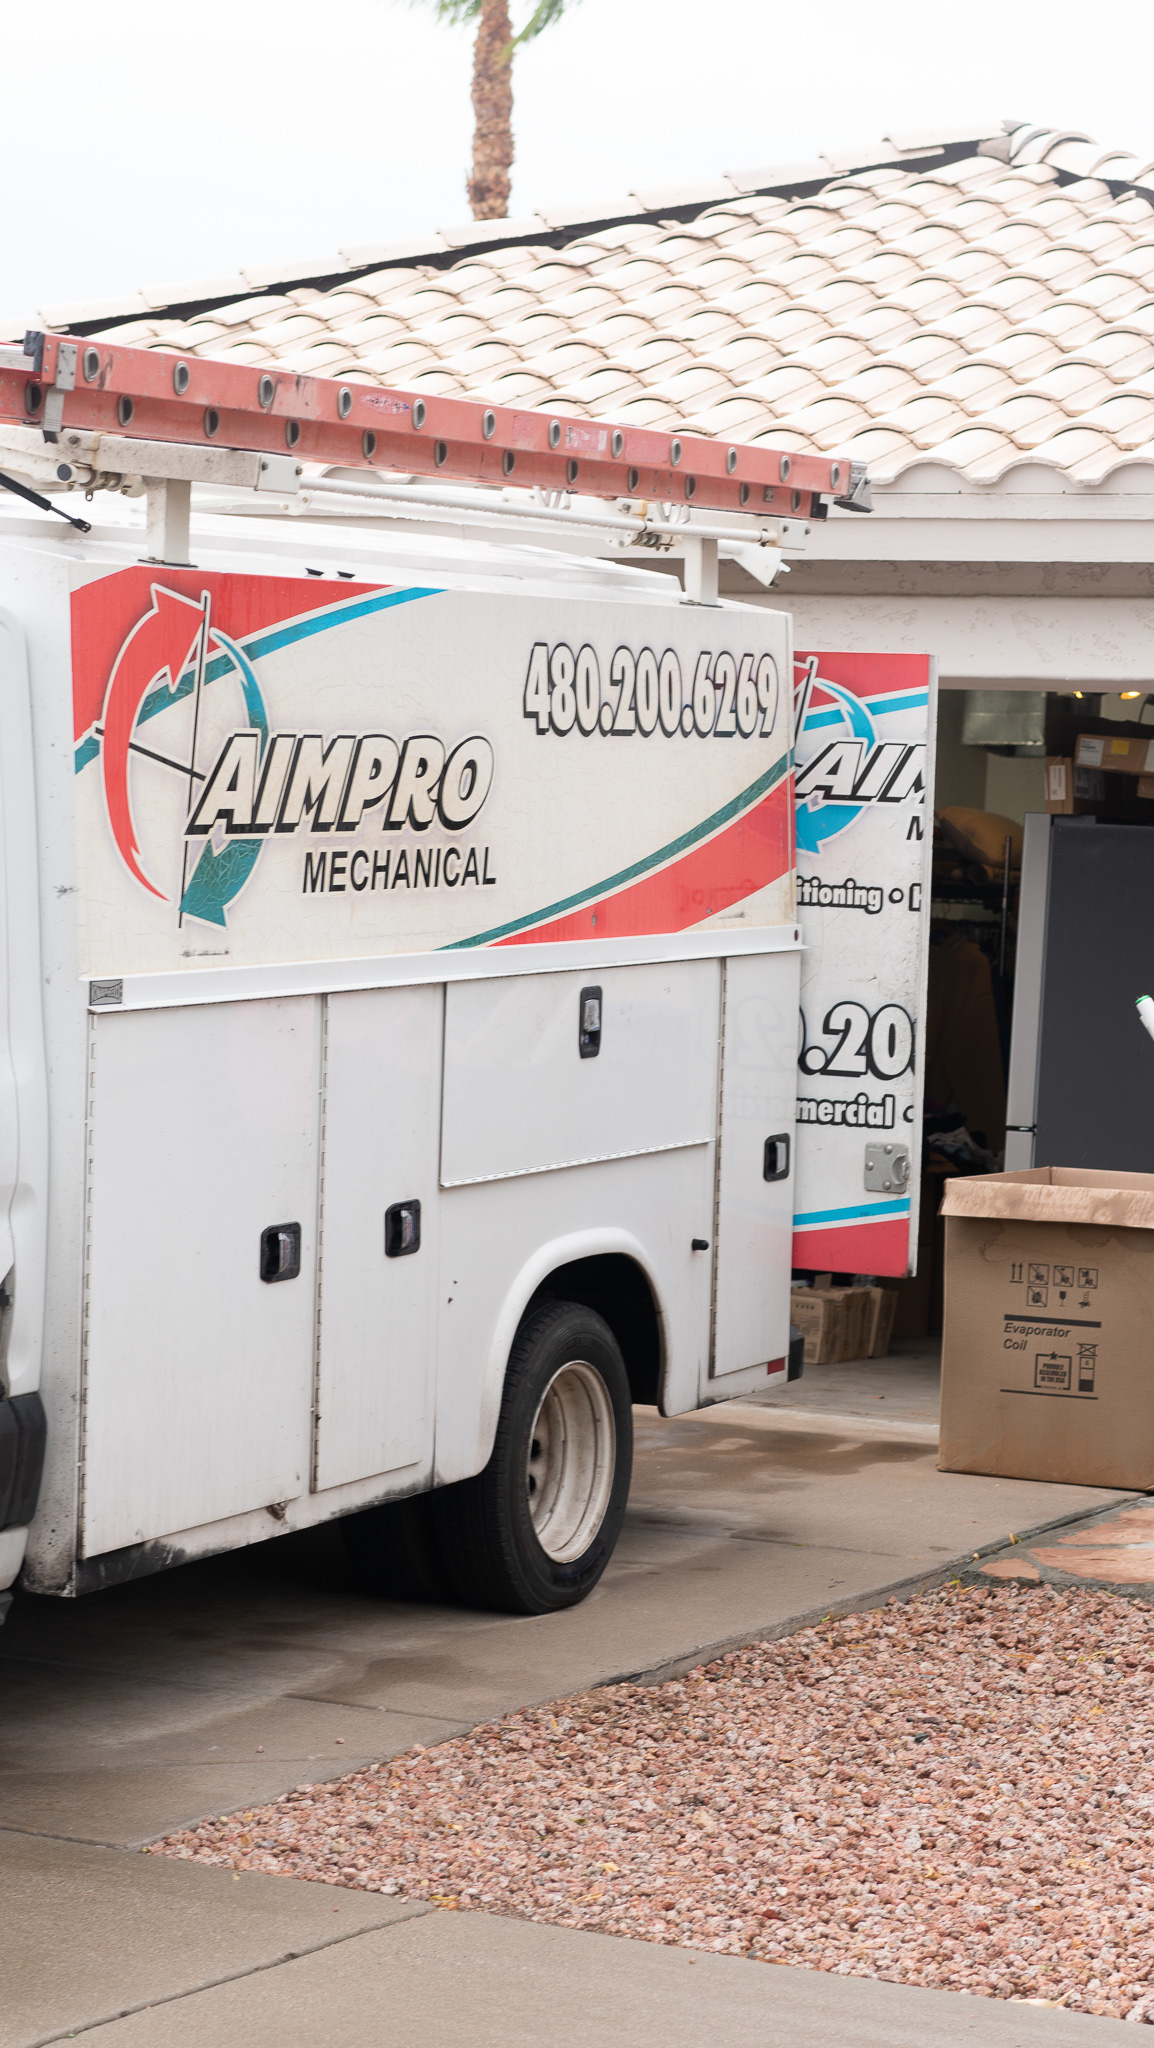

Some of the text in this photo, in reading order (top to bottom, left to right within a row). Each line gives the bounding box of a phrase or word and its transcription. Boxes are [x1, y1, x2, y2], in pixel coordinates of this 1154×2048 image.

[523, 642, 779, 739] 480.200.6269
[184, 733, 496, 836] AIMPRO
[302, 846, 497, 894] MECHANICAL
[798, 1000, 917, 1080] .20
[1003, 1338, 1028, 1351] Coil
[1004, 1322, 1071, 1337] Evaporator
